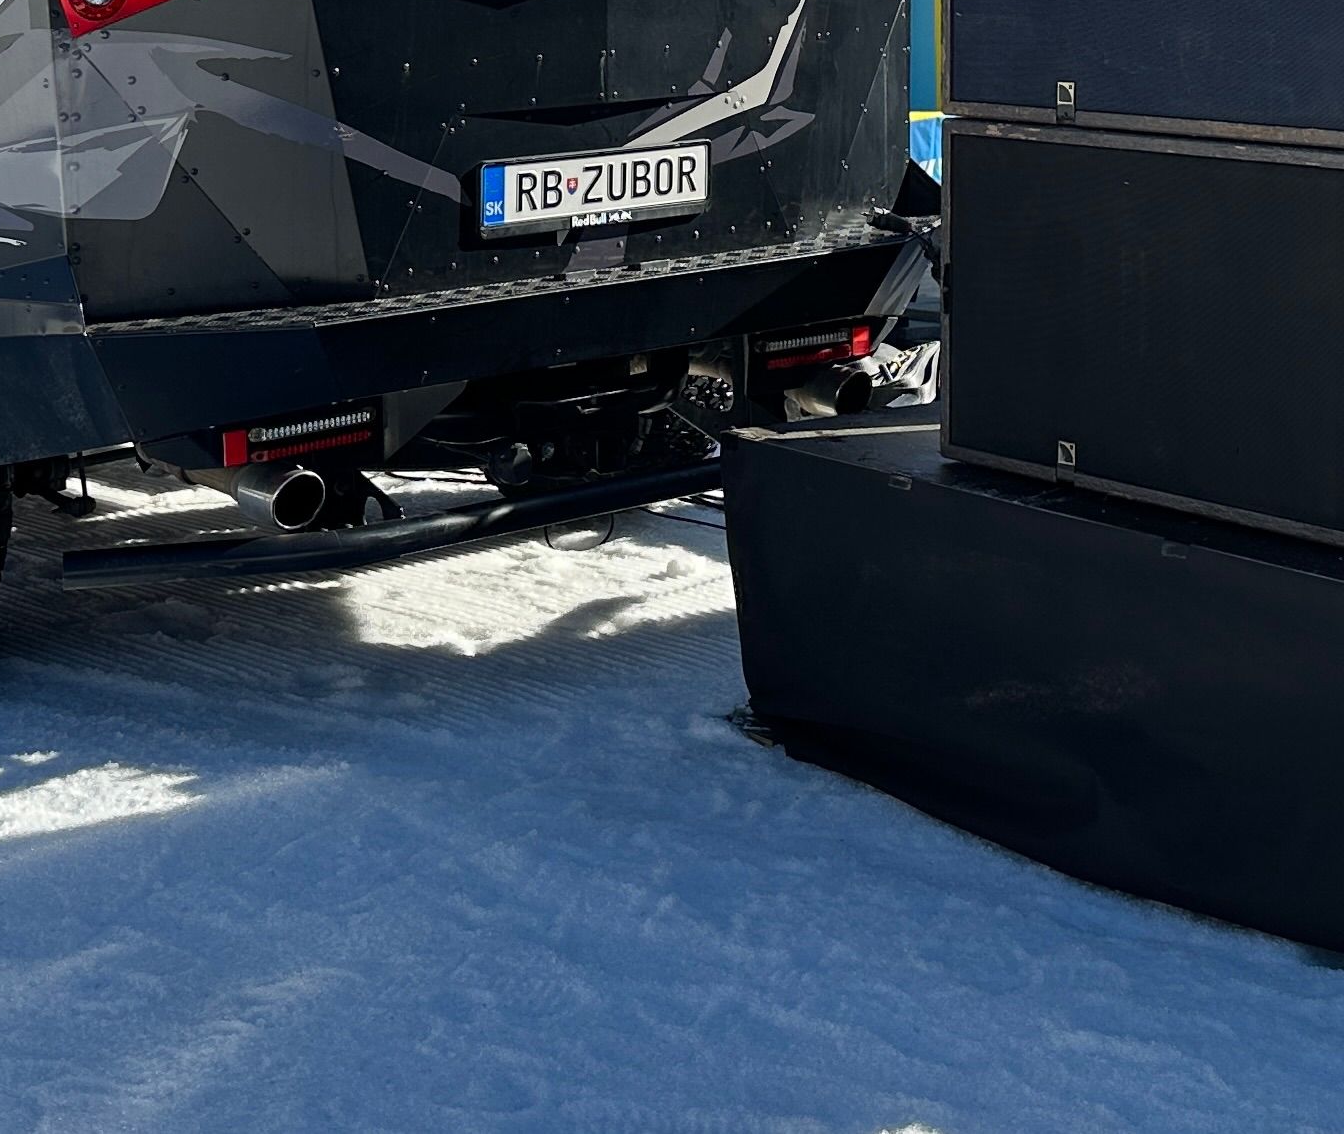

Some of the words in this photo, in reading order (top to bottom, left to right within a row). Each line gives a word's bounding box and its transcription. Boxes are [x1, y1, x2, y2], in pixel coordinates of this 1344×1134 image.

[516, 170, 563, 212] RB
[582, 155, 697, 205] ZUBOR
[485, 200, 503, 216] SK
